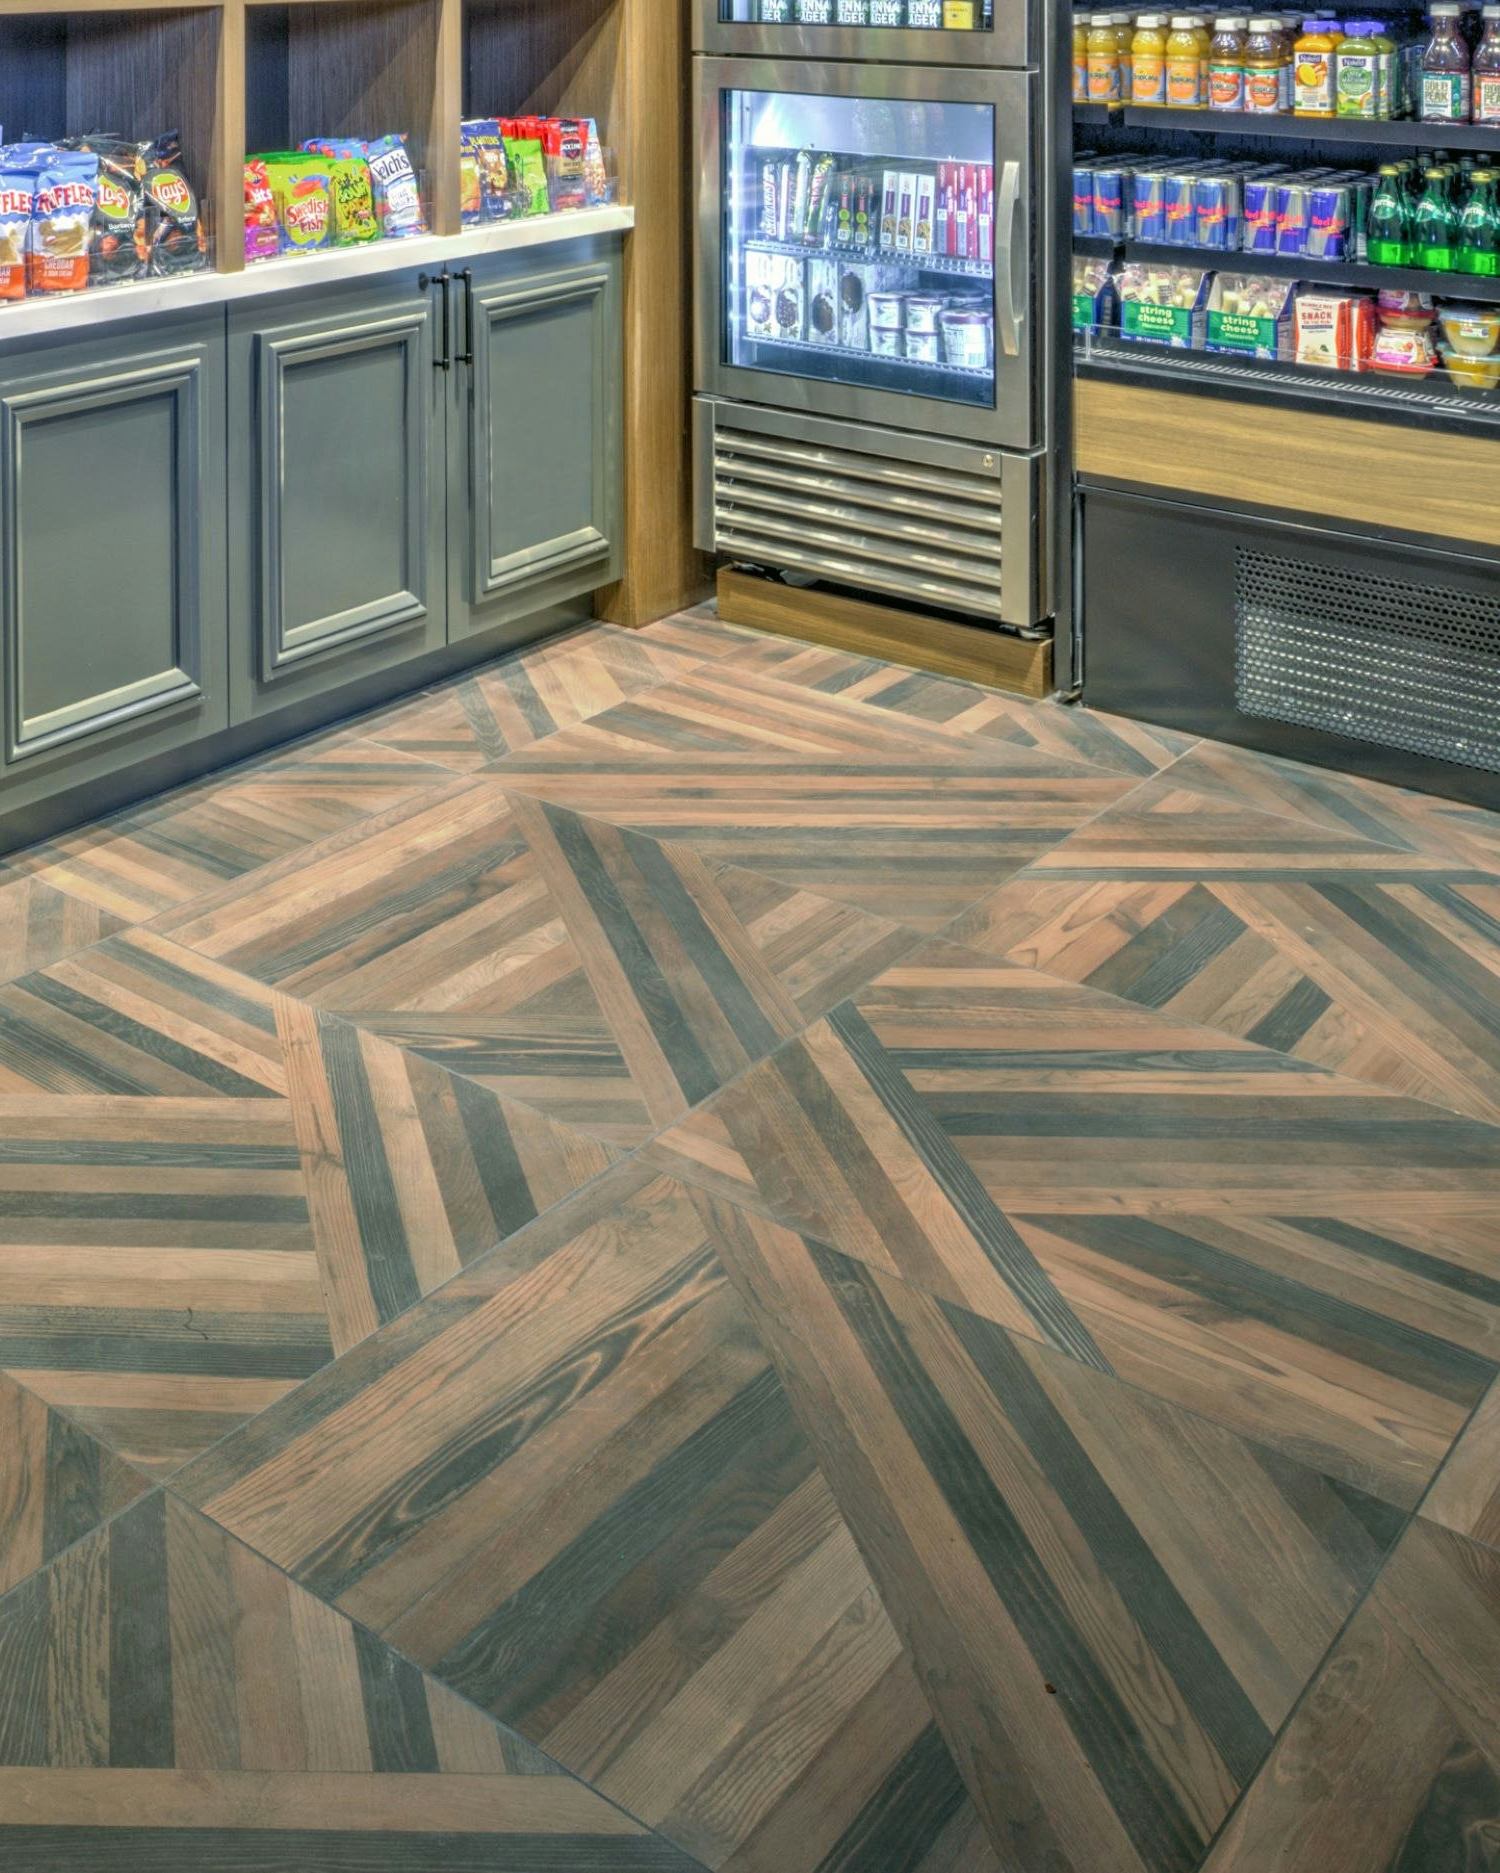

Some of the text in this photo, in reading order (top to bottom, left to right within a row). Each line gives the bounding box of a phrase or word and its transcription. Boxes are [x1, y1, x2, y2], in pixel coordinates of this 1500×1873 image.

[1424, 91, 1448, 104] PEAK
[38, 184, 93, 214] RUFFLES
[155, 180, 186, 205] Lay's
[286, 199, 329, 225] Swedish
[300, 215, 324, 233] Fish
[1140, 305, 1172, 317] string
[1301, 312, 1333, 321] SNACK
[1138, 313, 1174, 326] cheese
[1223, 315, 1257, 328] string
[1221, 323, 1259, 336] cheese
